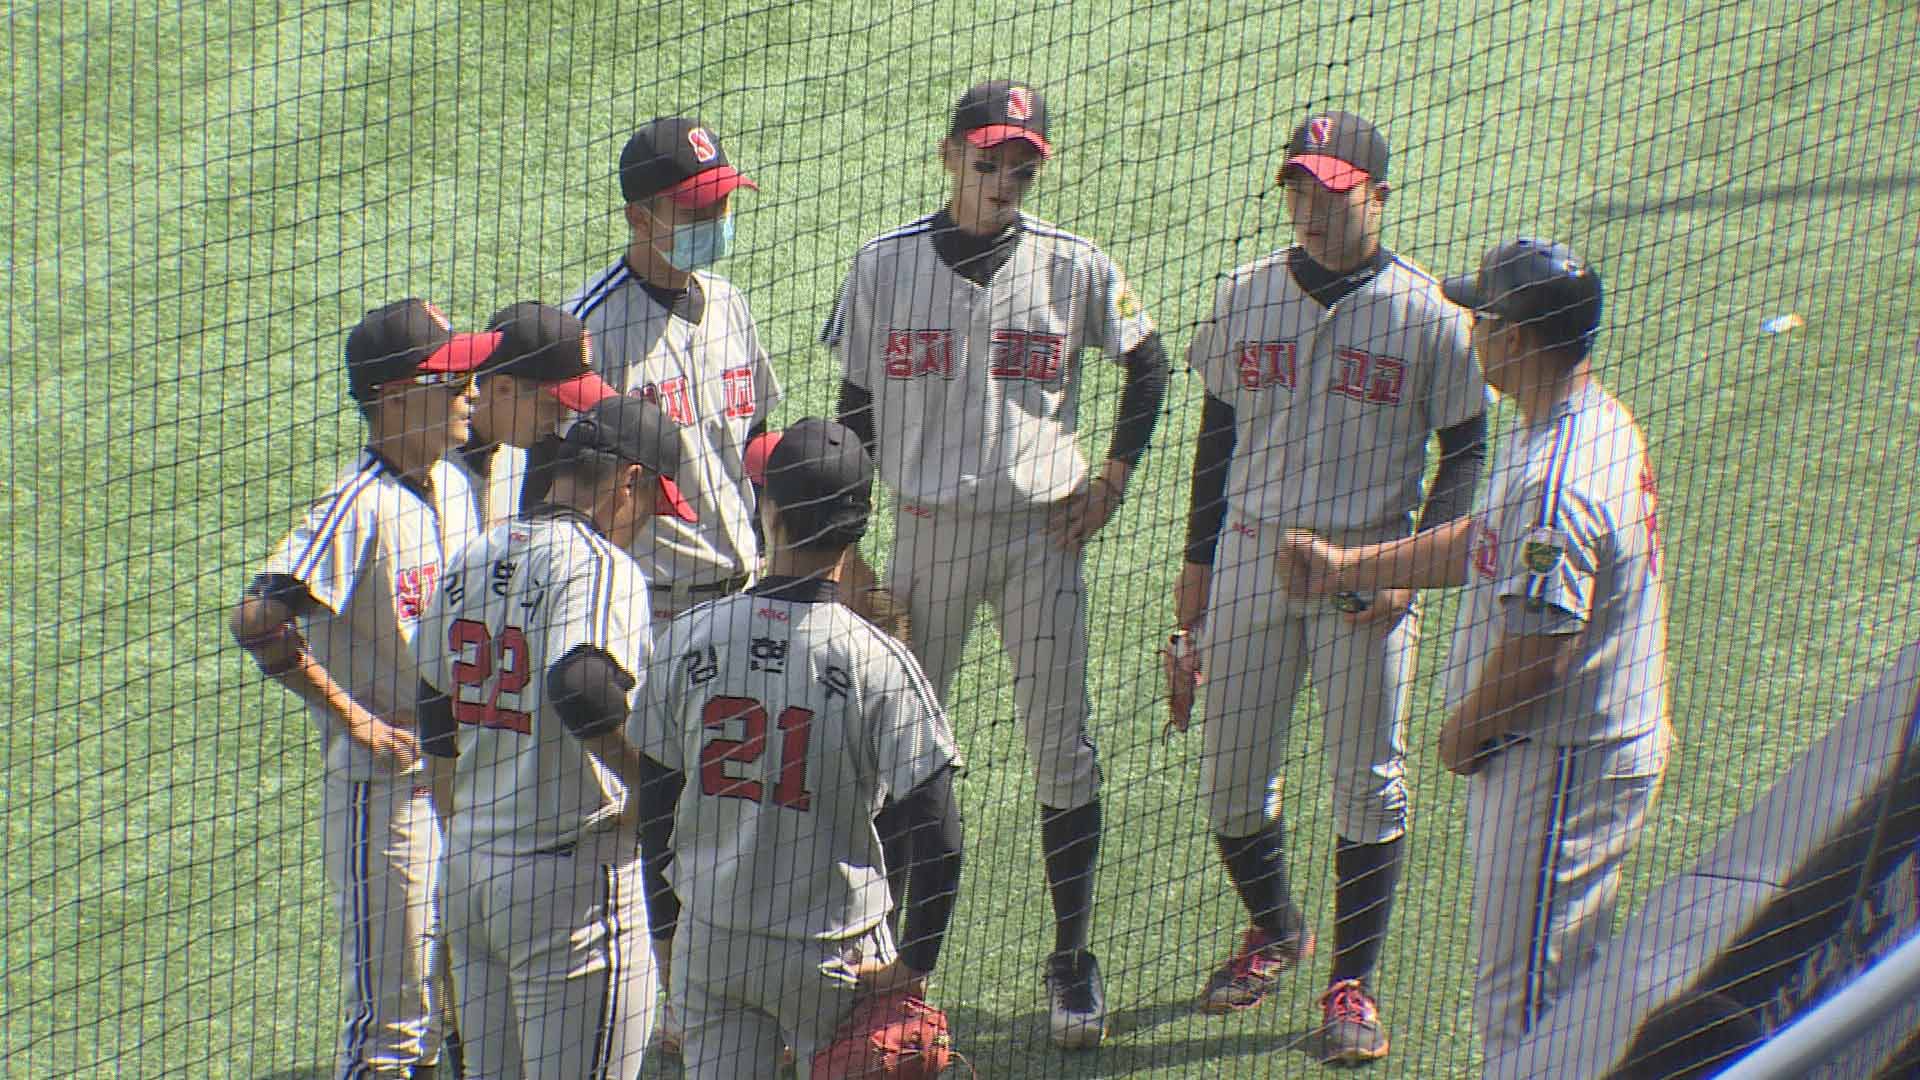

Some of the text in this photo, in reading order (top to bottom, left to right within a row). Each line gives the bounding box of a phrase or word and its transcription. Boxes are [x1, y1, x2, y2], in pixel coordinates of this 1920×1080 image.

[688, 127, 716, 162] S
[448, 618, 532, 735] 22
[699, 695, 815, 812] 21
